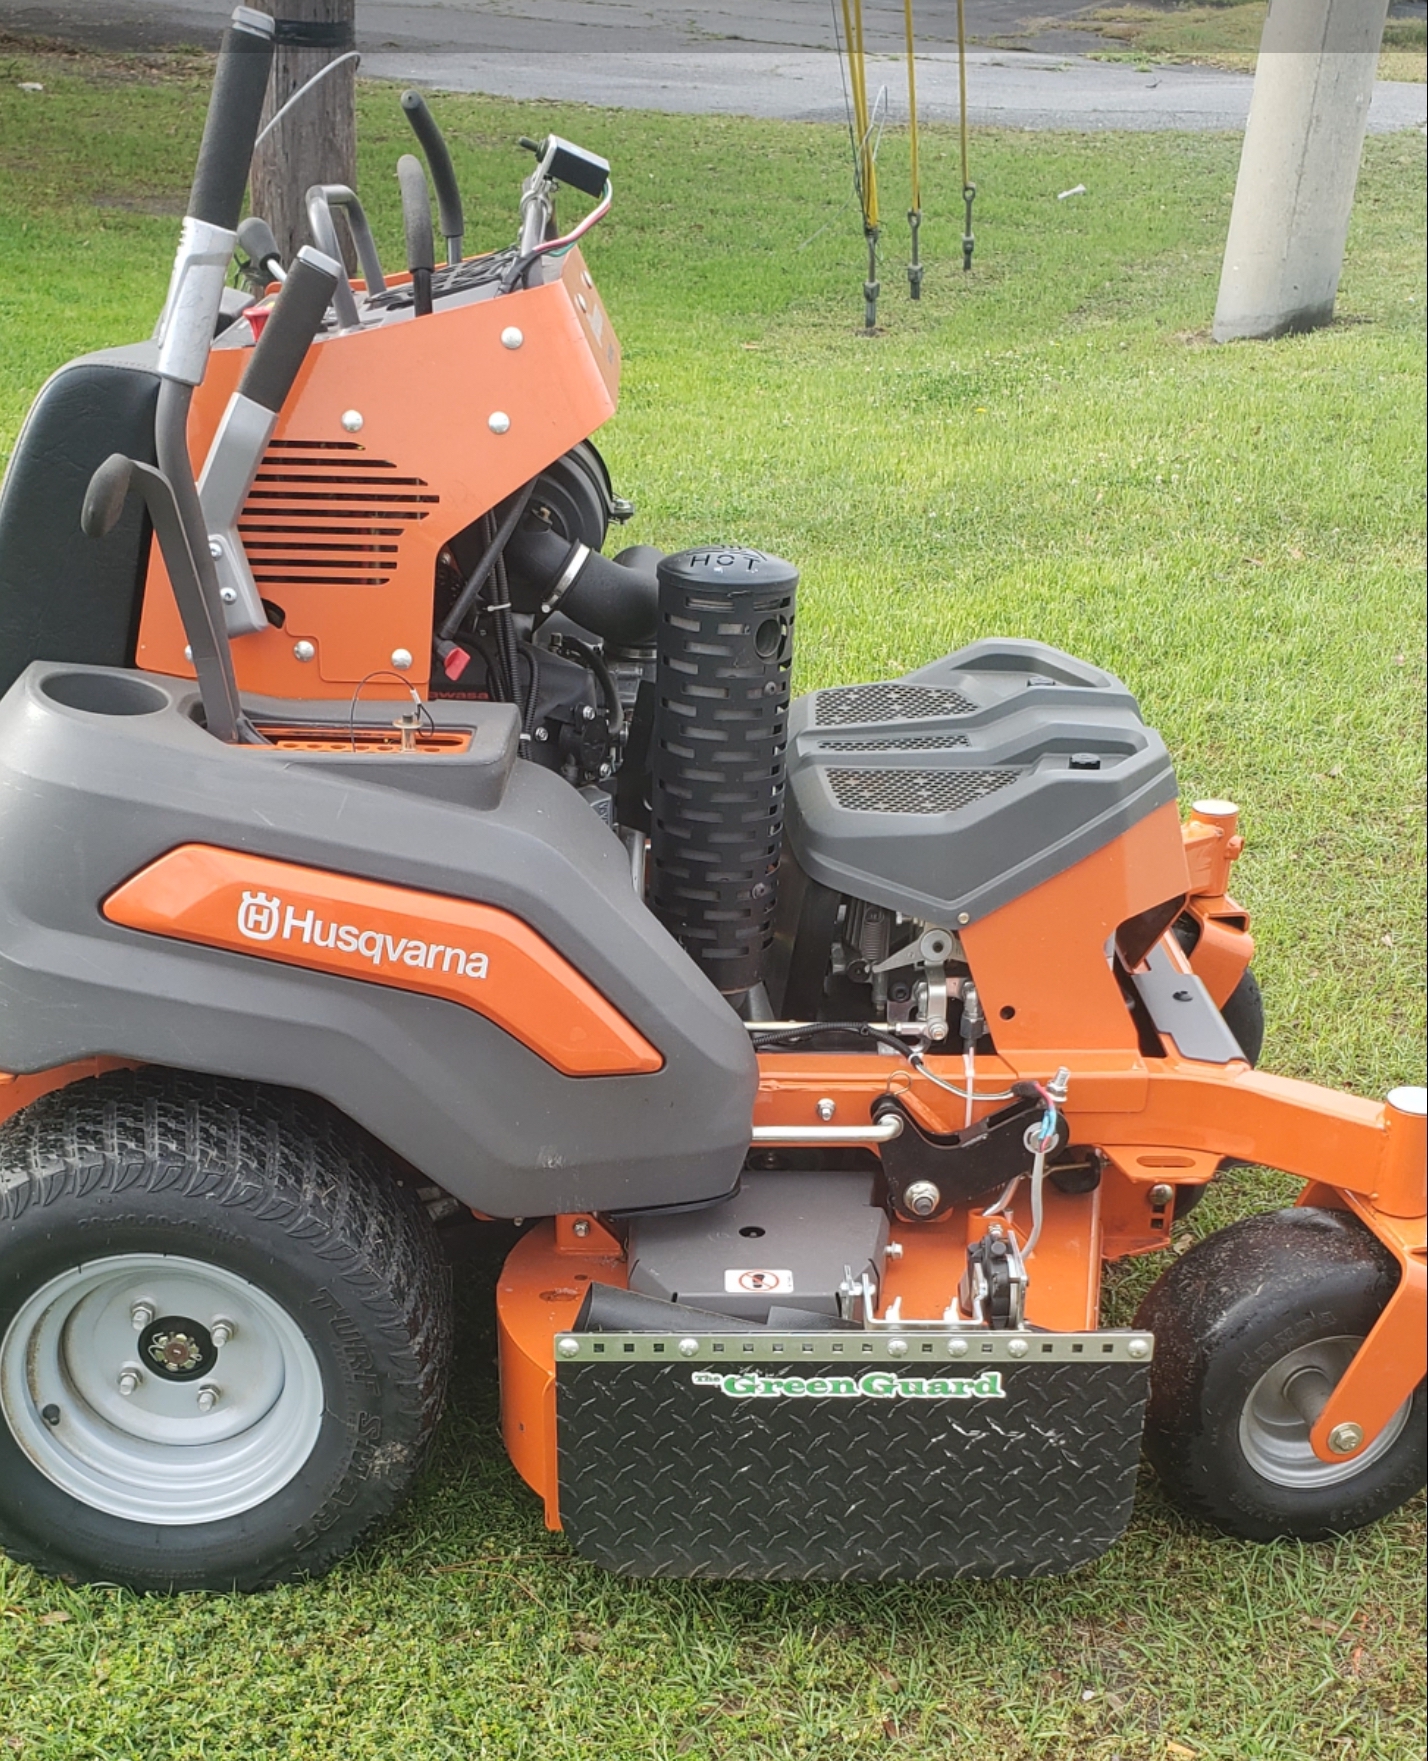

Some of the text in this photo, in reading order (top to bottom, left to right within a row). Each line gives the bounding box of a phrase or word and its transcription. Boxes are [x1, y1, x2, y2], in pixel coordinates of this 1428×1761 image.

[690, 553, 761, 571] HOT
[429, 691, 489, 699] awasa
[281, 905, 489, 979] Husqvarna
[309, 1286, 382, 1398] TURF
[694, 1374, 720, 1382] The
